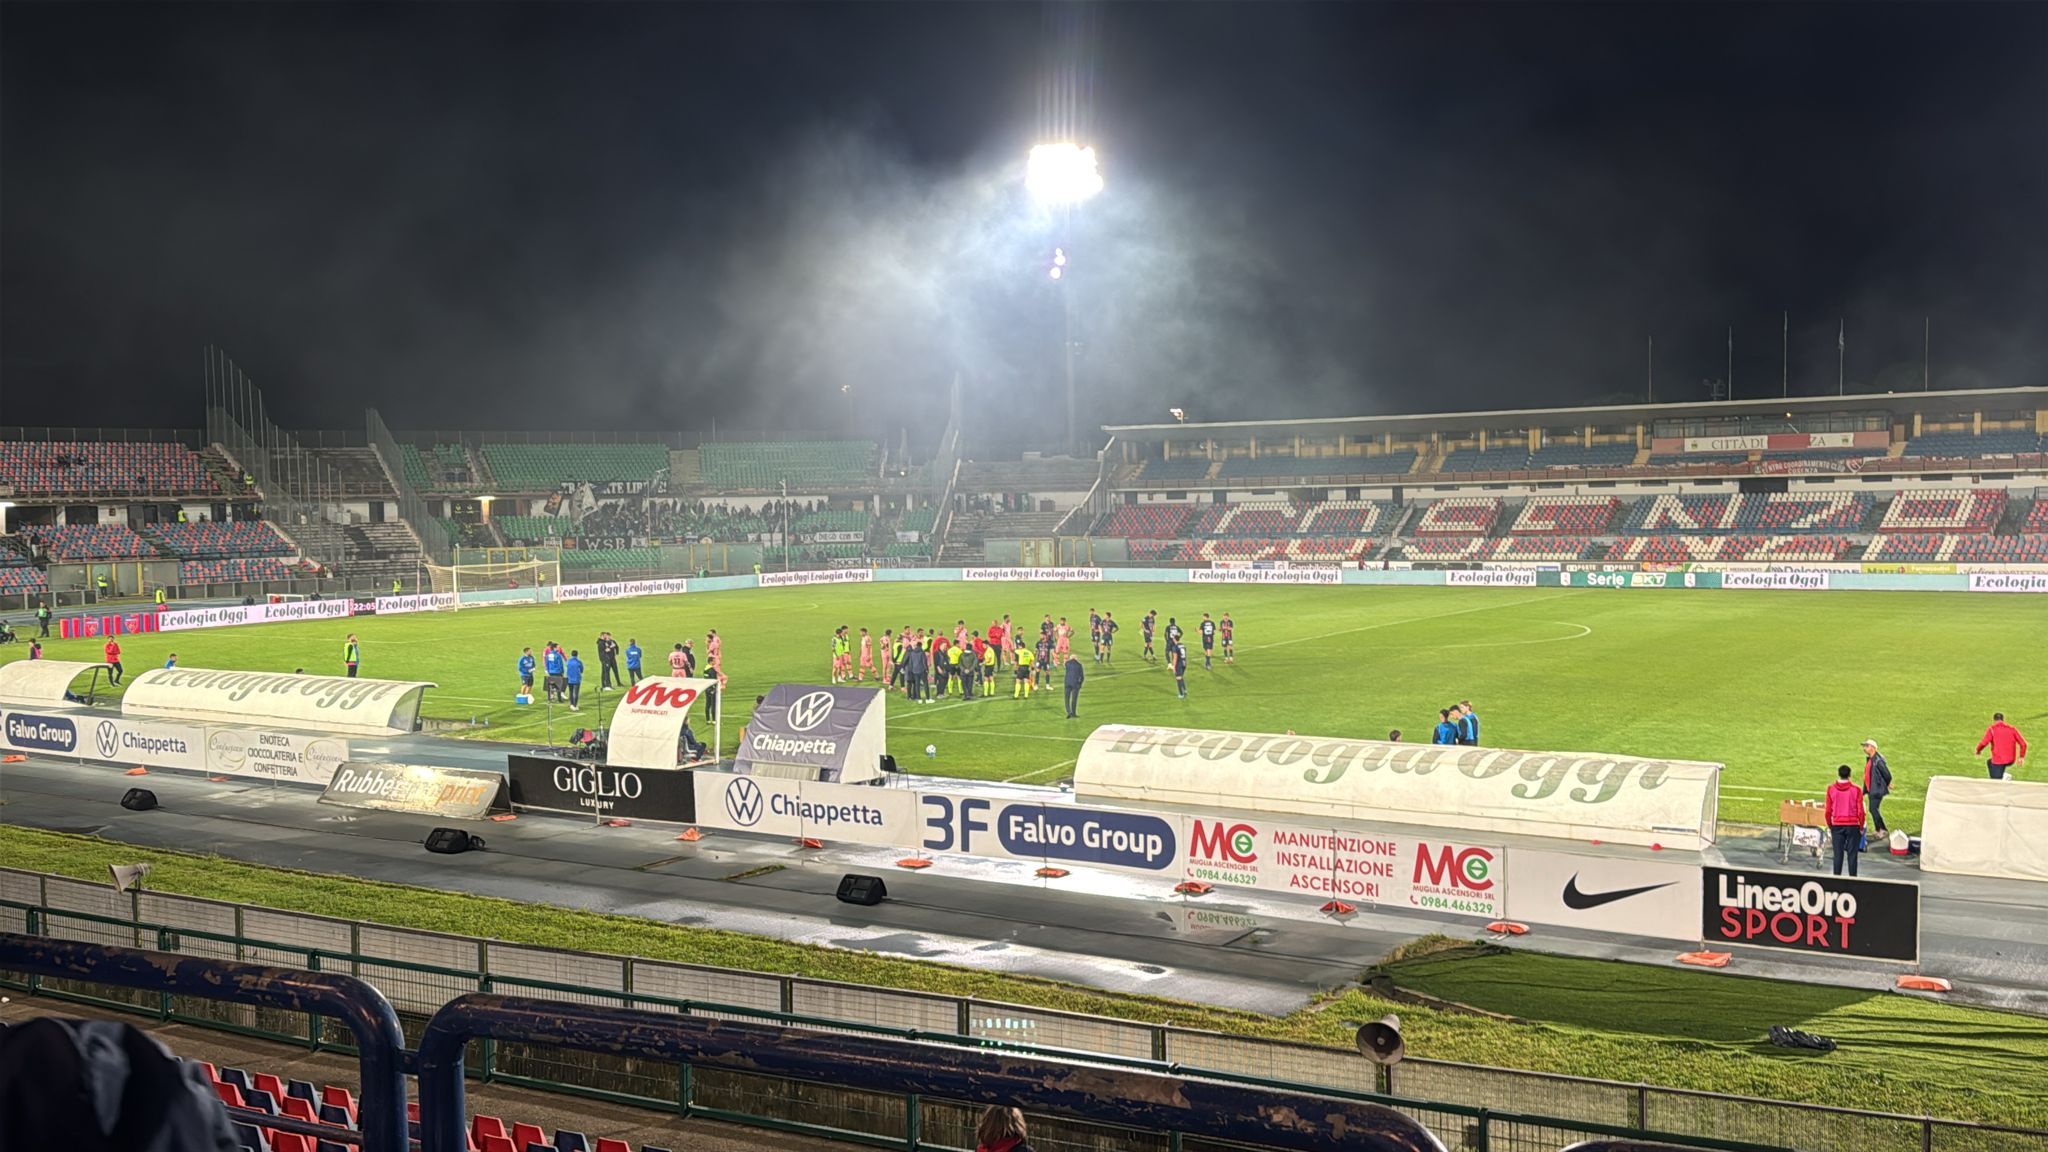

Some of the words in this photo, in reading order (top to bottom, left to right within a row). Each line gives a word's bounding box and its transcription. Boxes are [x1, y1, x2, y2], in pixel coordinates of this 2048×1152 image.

[1711, 436, 1747, 450] CITTÀ
[1750, 437, 1764, 449] DI
[761, 573, 793, 585] Ecologia
[794, 572, 810, 584] Oggi
[811, 571, 843, 582] Ecologia
[845, 569, 869, 580] Oggi
[966, 569, 1009, 579] Ecologia
[1010, 569, 1033, 579] Oggi
[1034, 569, 1075, 579] Ecologia
[1077, 569, 1099, 579] Oggi
[1192, 570, 1237, 582] Ecologia
[1238, 570, 1262, 582] Oggi
[1264, 571, 1311, 582] Ecologia
[1312, 571, 1338, 582] Oggi
[1450, 571, 1503, 584] Ecologia
[1505, 572, 1535, 584] Oggi
[1587, 573, 1625, 585] Serie
[1724, 573, 1786, 587] Ecologia
[1789, 574, 1824, 587] Oggi
[600, 583, 621, 596] Oggi
[624, 581, 662, 593] Ecologia
[663, 580, 684, 592] Oggi
[160, 612, 217, 628] Ecologia
[219, 607, 248, 625] Oggi
[264, 603, 317, 619] Ecologia
[318, 600, 346, 616] Oggi
[354, 602, 376, 611] 22:05
[9, 720, 36, 739] Falvo
[39, 723, 72, 747] Group
[259, 735, 290, 747] ENOTECA
[123, 732, 187, 755] Chiappetta
[753, 733, 836, 756] Chiappetta
[247, 747, 297, 762] CIOCCOLATERIA
[298, 753, 303, 762] E
[253, 762, 298, 776] CONFETTERIA
[553, 765, 643, 799] GIGLIO
[580, 798, 614, 810] LUXURY
[770, 793, 883, 826] Chiappetta
[922, 795, 990, 852] 3F
[1009, 814, 1076, 846] Falvo
[1082, 820, 1163, 861] Group
[1273, 831, 1397, 856] MANUTENZIONE
[1189, 858, 1213, 867] MUGLIA
[1214, 861, 1249, 872] ASCENSORI
[1249, 865, 1259, 873] SRL
[1276, 851, 1394, 878] INSTALLAZIONE
[1196, 868, 1257, 885] 0984.466329
[1290, 873, 1380, 898] ASCENSORI
[1413, 884, 1440, 894] MUGLIA
[1442, 887, 1483, 898] ASCENSORI
[1484, 892, 1495, 900] SRL
[1719, 874, 1857, 918] LineaOro
[1421, 896, 1493, 914] 0984.466329
[1720, 906, 1856, 949] SPORT
